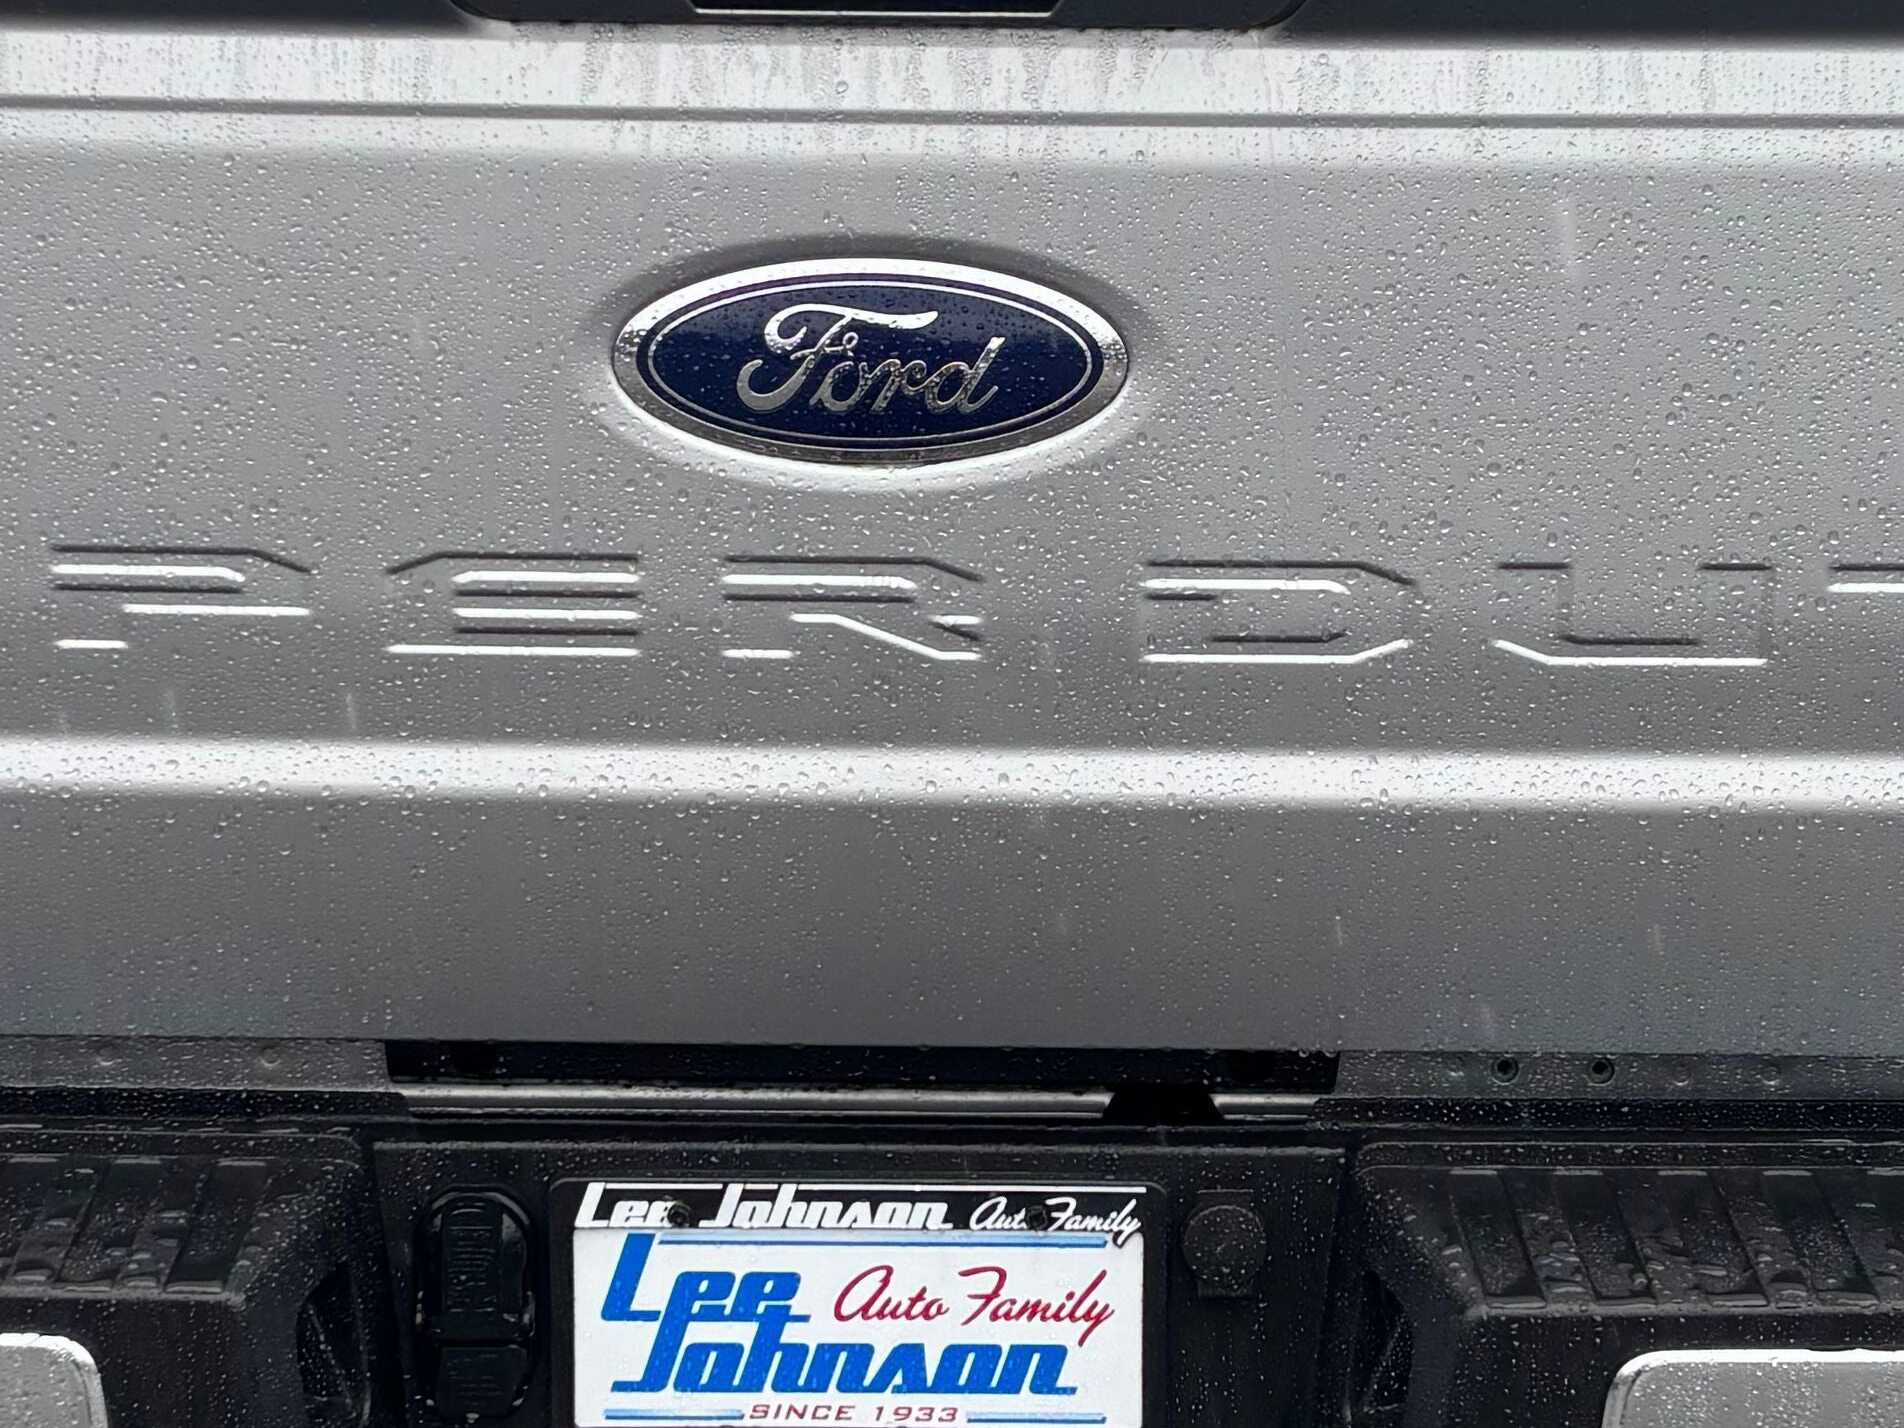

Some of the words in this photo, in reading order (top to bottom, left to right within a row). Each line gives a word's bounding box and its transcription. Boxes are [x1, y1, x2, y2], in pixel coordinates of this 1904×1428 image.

[736, 303, 1006, 416] Ford
[699, 1183, 954, 1230] Johnson
[969, 1196, 1038, 1230] Aut
[1045, 1196, 1142, 1246] Family
[601, 1233, 811, 1322] Lee
[834, 1265, 949, 1322] Auto
[958, 1266, 1115, 1347] Family
[611, 1310, 1077, 1395] Johnson
[749, 1403, 856, 1421] SINCE
[875, 1405, 959, 1423] 1933
